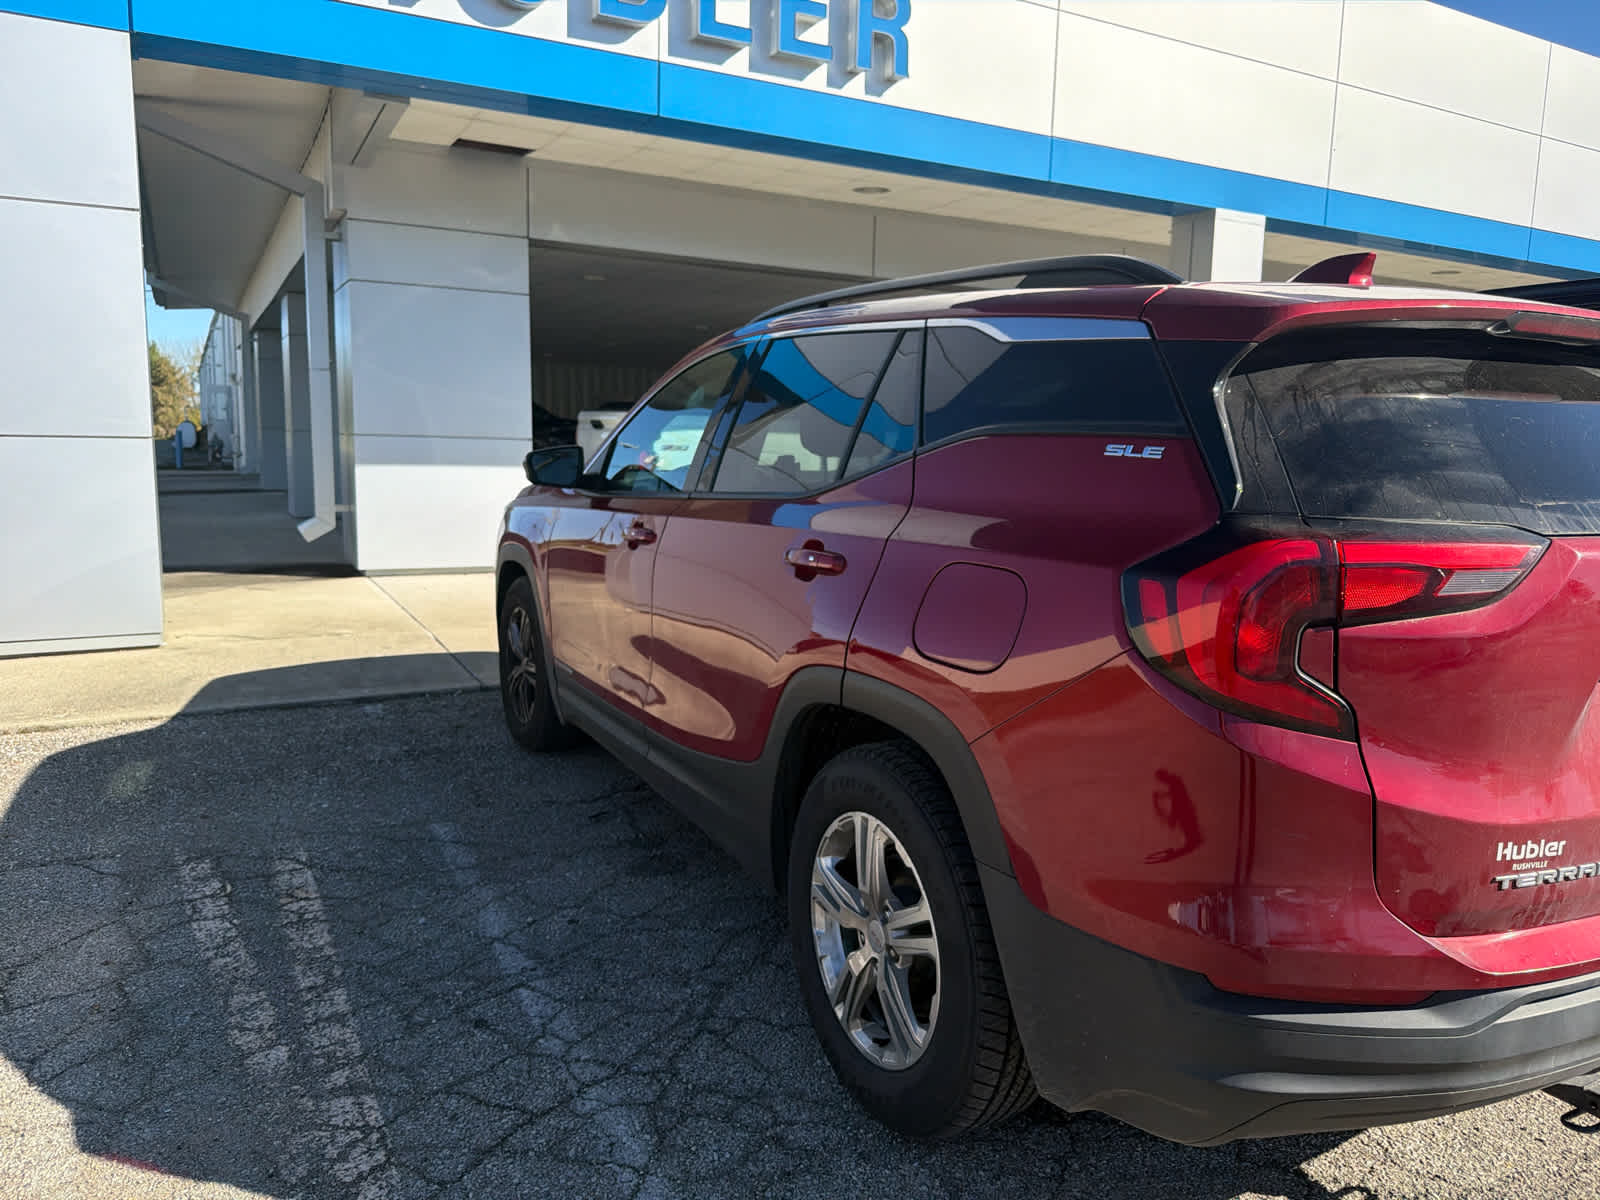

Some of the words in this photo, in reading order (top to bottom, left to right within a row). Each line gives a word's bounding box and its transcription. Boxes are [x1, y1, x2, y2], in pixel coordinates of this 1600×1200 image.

[1103, 443, 1166, 460] SLE
[1496, 839, 1566, 861] Hubler
[1512, 860, 1548, 871] RUSHVILLE
